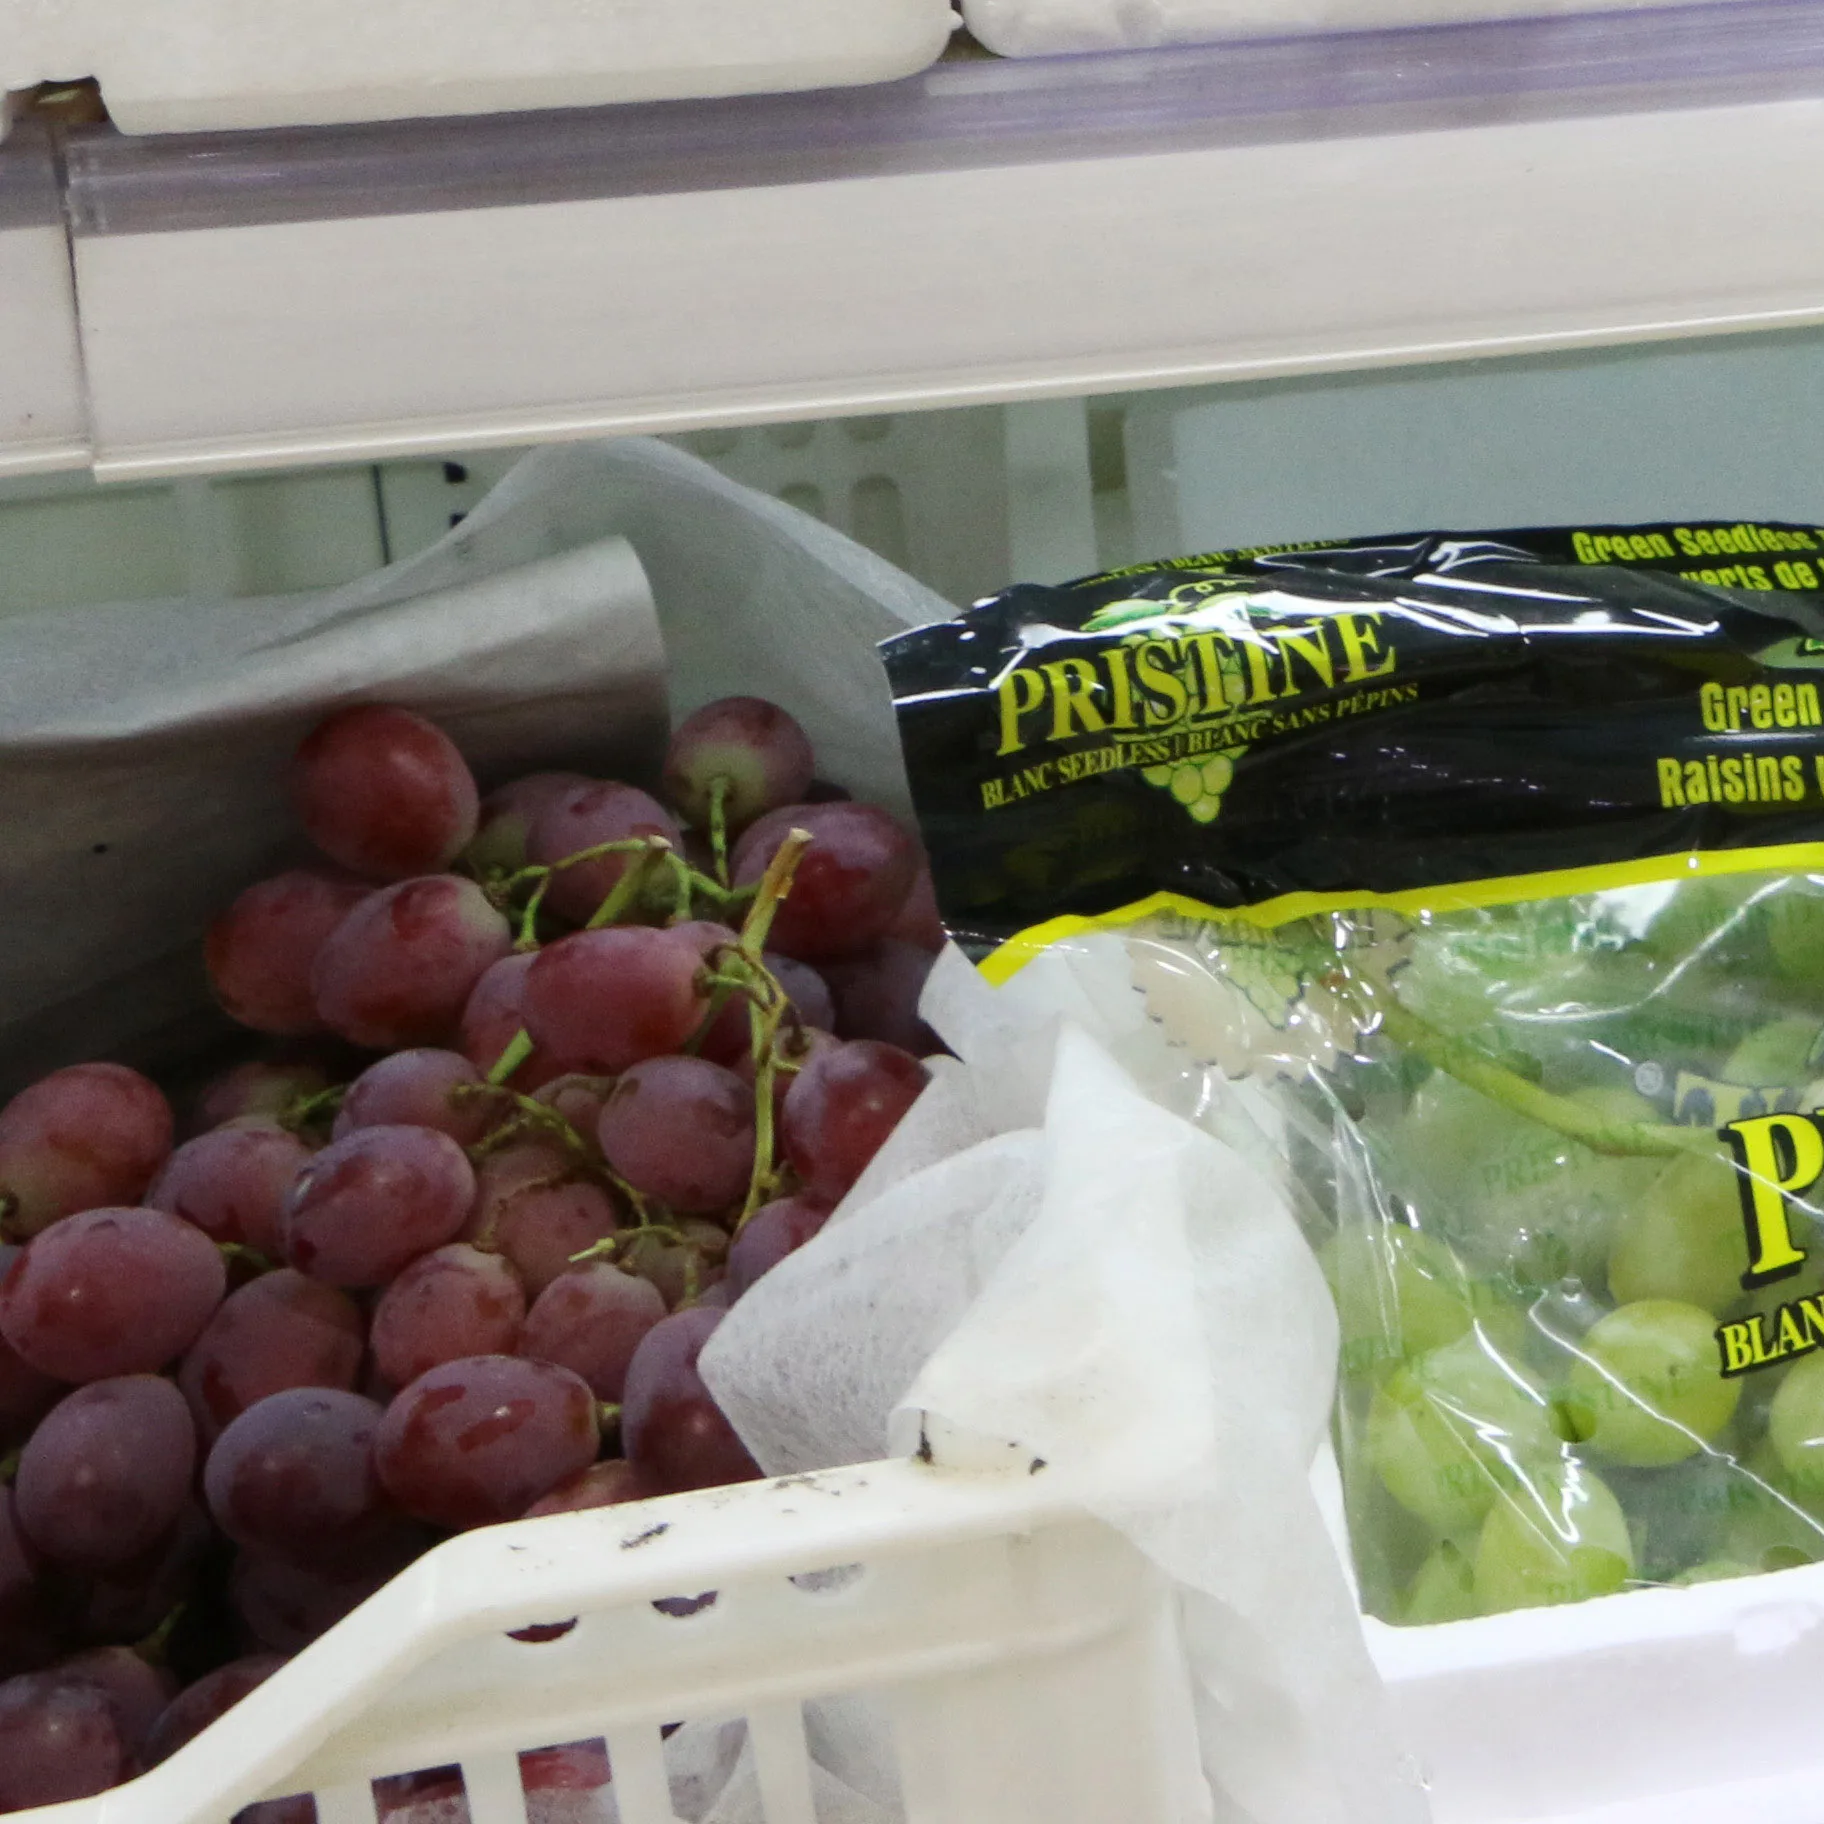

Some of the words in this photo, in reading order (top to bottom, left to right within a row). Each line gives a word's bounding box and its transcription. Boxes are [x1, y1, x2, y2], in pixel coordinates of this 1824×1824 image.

[1572, 530, 1676, 564] Green
[1772, 560, 1820, 590] de
[995, 610, 1398, 758] PRISTINE
[1700, 680, 1823, 733] Green
[980, 763, 1053, 811] BLANC
[1057, 732, 1170, 783] SEEDLESS
[1187, 717, 1271, 754] BLANC
[1272, 703, 1332, 735] SANS
[1336, 681, 1420, 719] PÉPINS
[1656, 753, 1806, 809] Raisins
